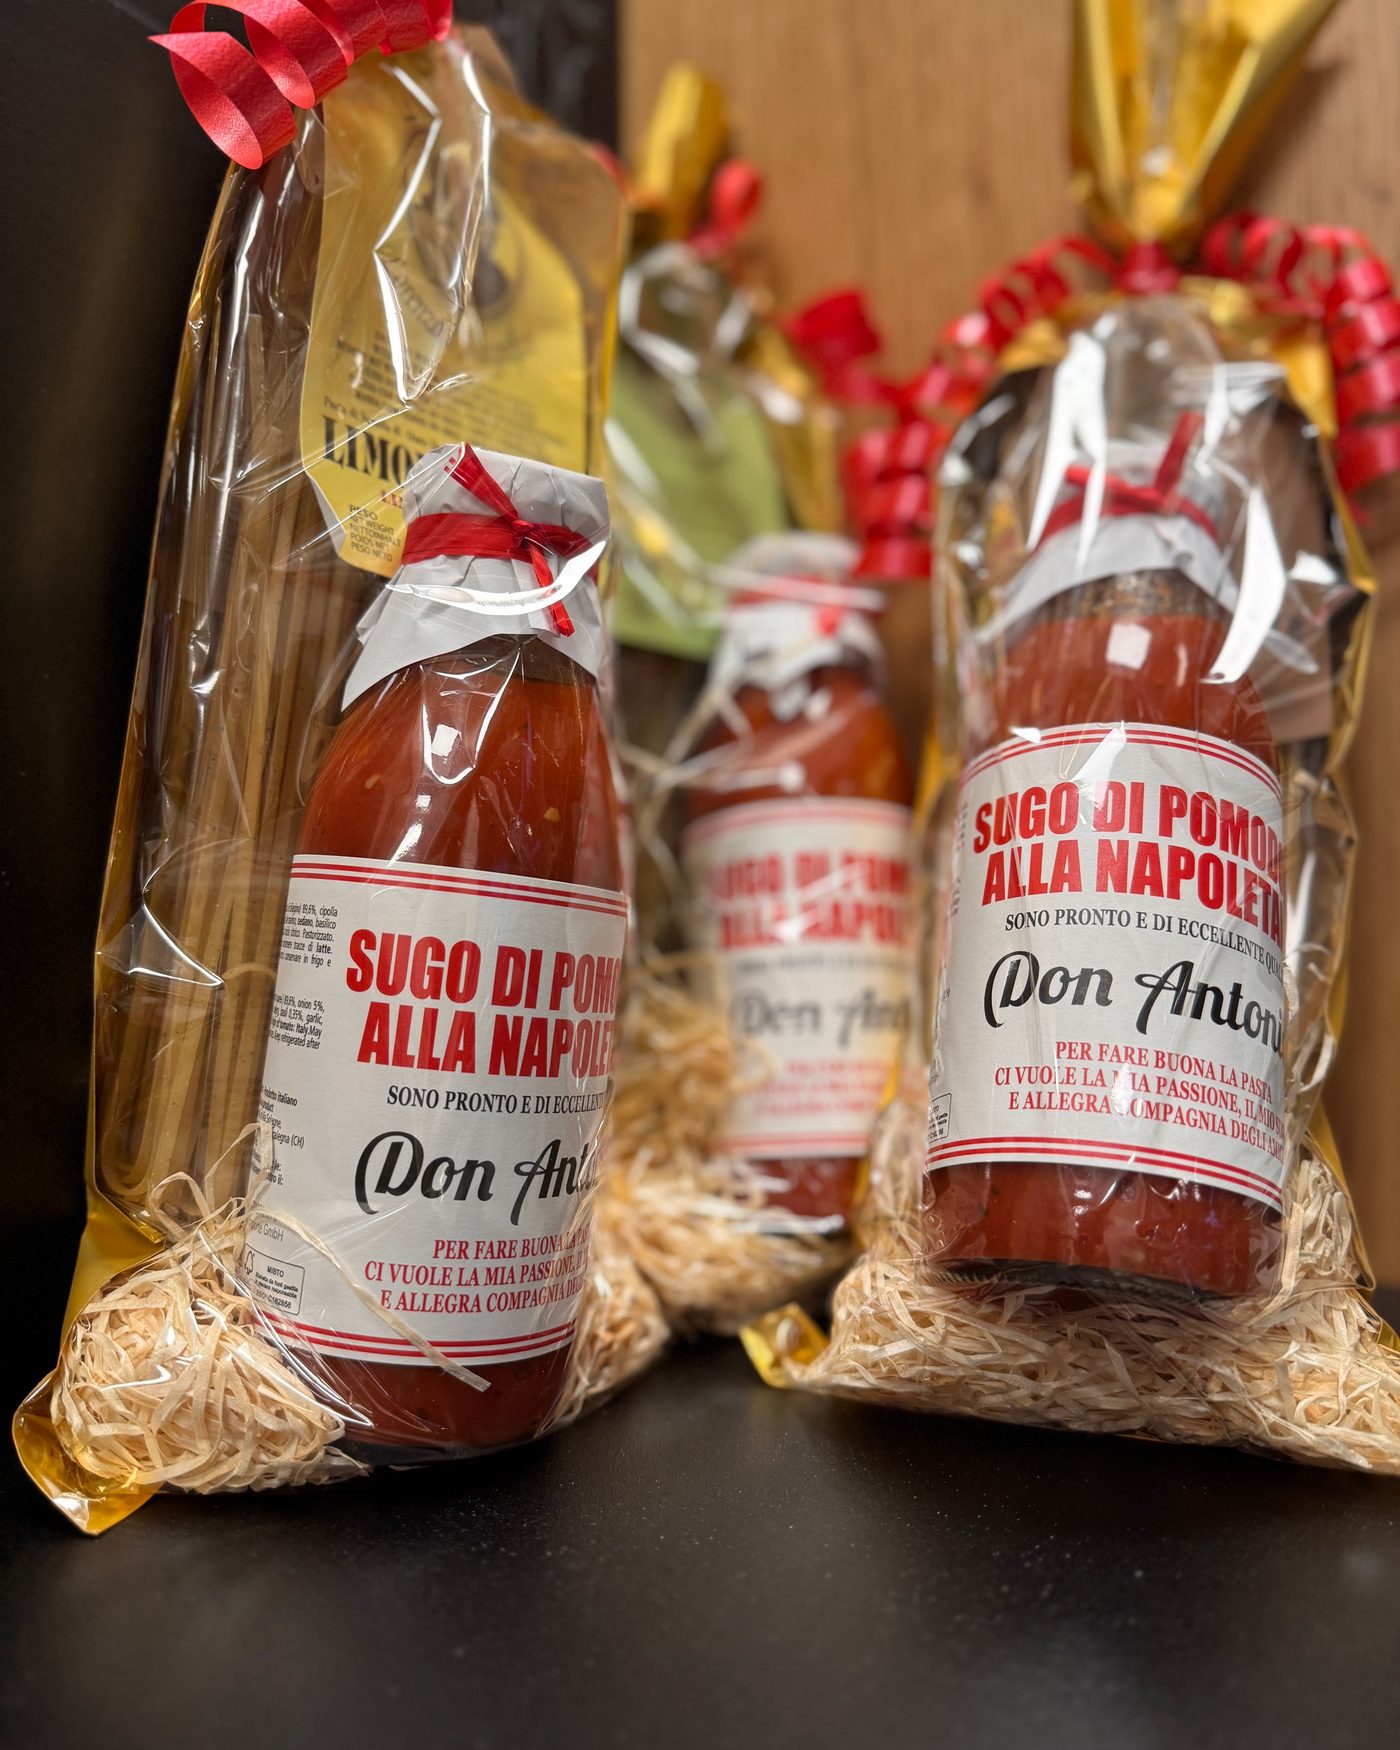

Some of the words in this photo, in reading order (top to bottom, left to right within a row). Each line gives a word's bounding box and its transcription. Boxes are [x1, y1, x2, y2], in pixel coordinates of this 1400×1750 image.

[322, 414, 428, 487] LIMO
[973, 780, 1080, 854] SUGO
[1092, 780, 1145, 834] DI
[981, 839, 1082, 906] ALLA
[315, 916, 337, 930] basilico
[319, 905, 338, 918] cipolla
[302, 928, 335, 942] Pastorizzato.
[316, 942, 333, 955] latte.
[1005, 910, 1049, 932] SONO
[1054, 908, 1131, 928] PRONTO
[1136, 912, 1147, 929] E
[1152, 914, 1172, 934] DI
[1178, 918, 1265, 965] ECCELLENTE
[310, 953, 324, 968] frigo
[326, 958, 332, 967] e
[345, 929, 482, 1004] SUGO
[491, 945, 544, 1009] DI
[984, 950, 1114, 1029] Don
[297, 997, 312, 1010] onion
[312, 1000, 325, 1014] 5%,
[306, 1037, 321, 1050] after
[356, 1001, 477, 1074] ALLA
[1055, 1041, 1092, 1061] PER
[1098, 1043, 1149, 1067] FARE
[1154, 1049, 1216, 1081] BUONA
[1219, 1064, 1239, 1088] LA
[1241, 1071, 1273, 1105] PASTA
[277, 1091, 298, 1107] italiano
[386, 1085, 439, 1110] SONO
[444, 1089, 515, 1114] PRONTO
[520, 1095, 532, 1114] E
[534, 1095, 551, 1114] DI
[995, 1068, 1010, 1086] CI
[1015, 1065, 1076, 1086] VUOLE
[1081, 1067, 1107, 1088] LA
[1155, 1076, 1242, 1118] PASSIONE,
[1245, 1098, 1257, 1121] IL
[1008, 1092, 1019, 1110] E
[1022, 1091, 1112, 1115] ALLEGRA
[1231, 1118, 1266, 1151] DEGLI
[290, 1134, 305, 1149] (CH)
[354, 1130, 497, 1215] Don
[263, 1222, 285, 1243] GmbH
[433, 1239, 470, 1260] PER
[473, 1240, 518, 1261] FARE
[520, 1233, 563, 1258] BUONA
[364, 1260, 384, 1281] CI
[388, 1262, 453, 1287] VUOLE
[456, 1266, 483, 1287] LA
[485, 1265, 516, 1286] MIA
[380, 1289, 392, 1310] E
[394, 1290, 482, 1314] ALLEGRA
[485, 1283, 565, 1313] COMPAGNIA
